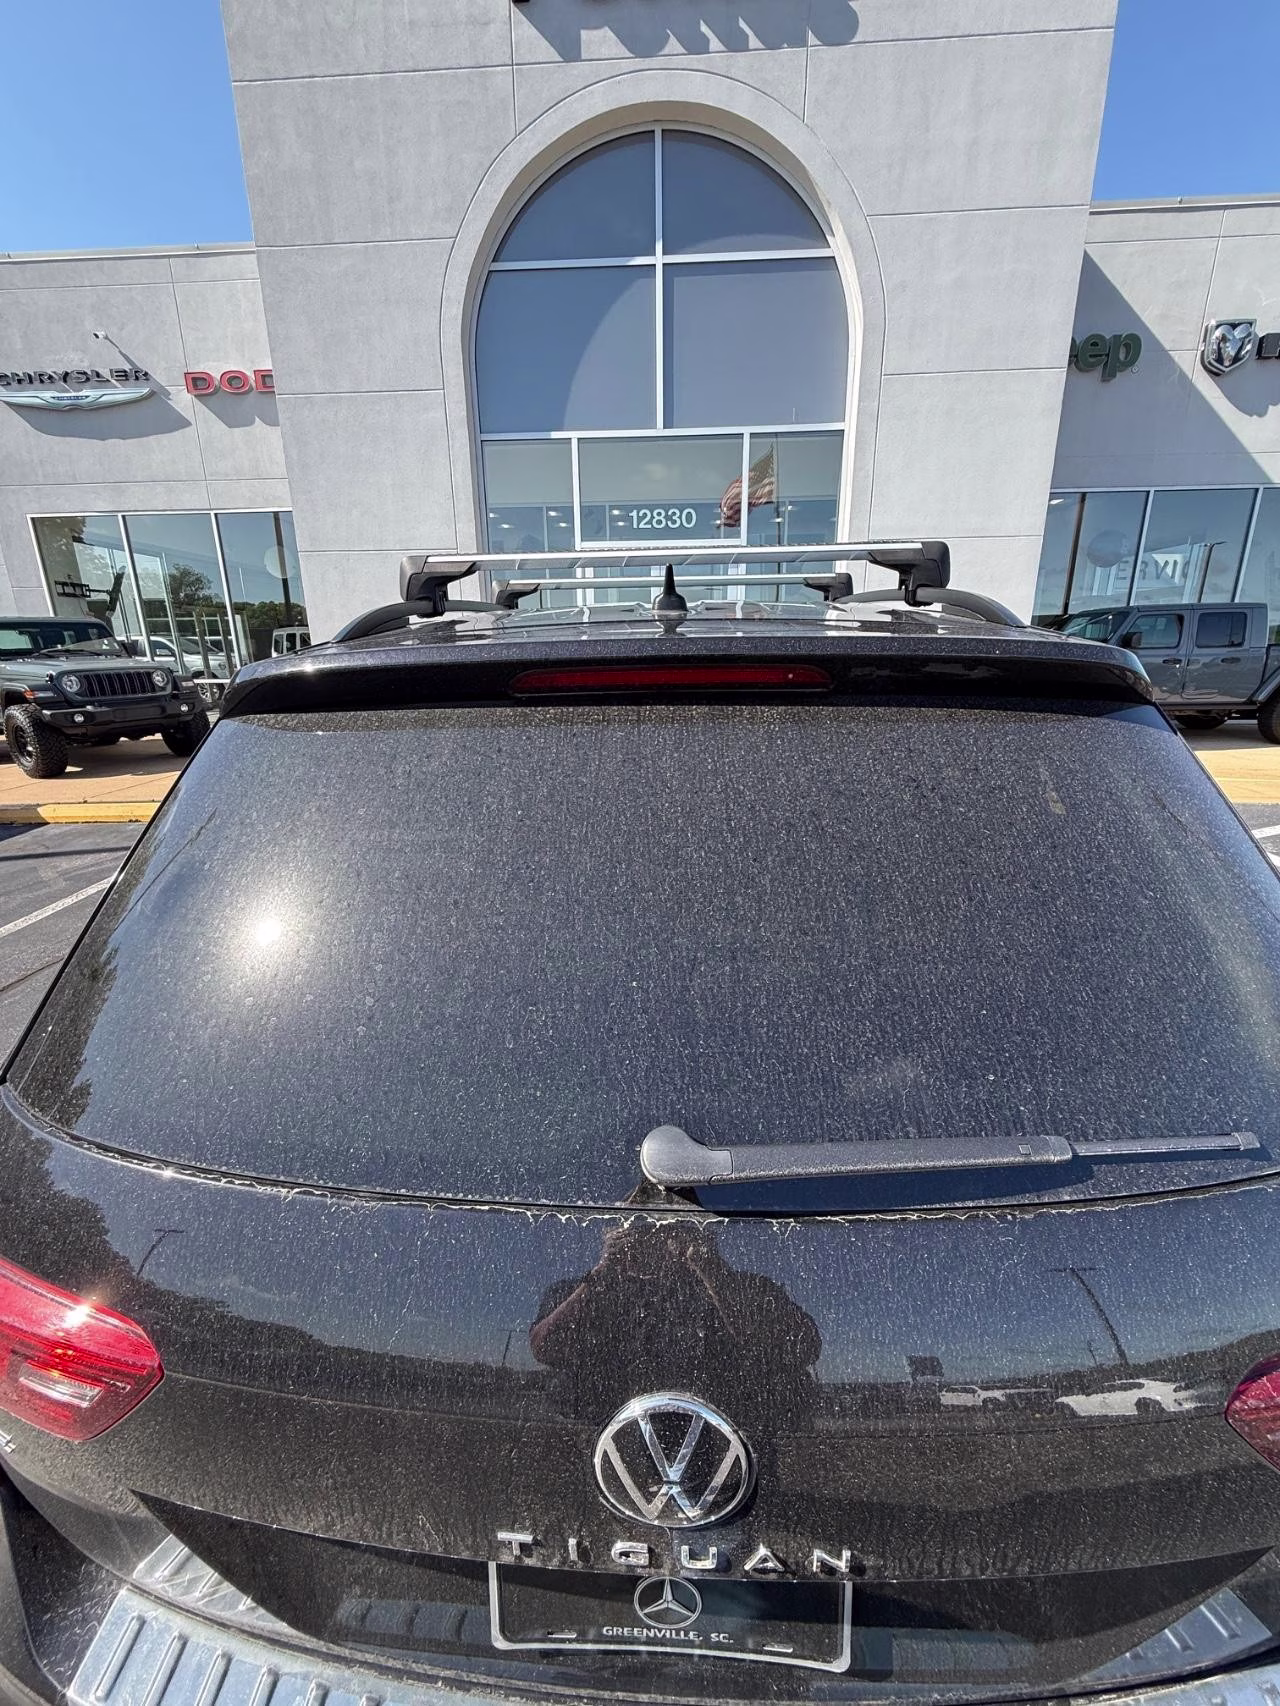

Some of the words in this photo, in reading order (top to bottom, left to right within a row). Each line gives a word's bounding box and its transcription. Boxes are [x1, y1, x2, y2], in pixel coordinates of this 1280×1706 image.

[1068, 333, 1142, 382] ep
[629, 508, 697, 529] 12830
[497, 1532, 851, 1573] TIGUAN
